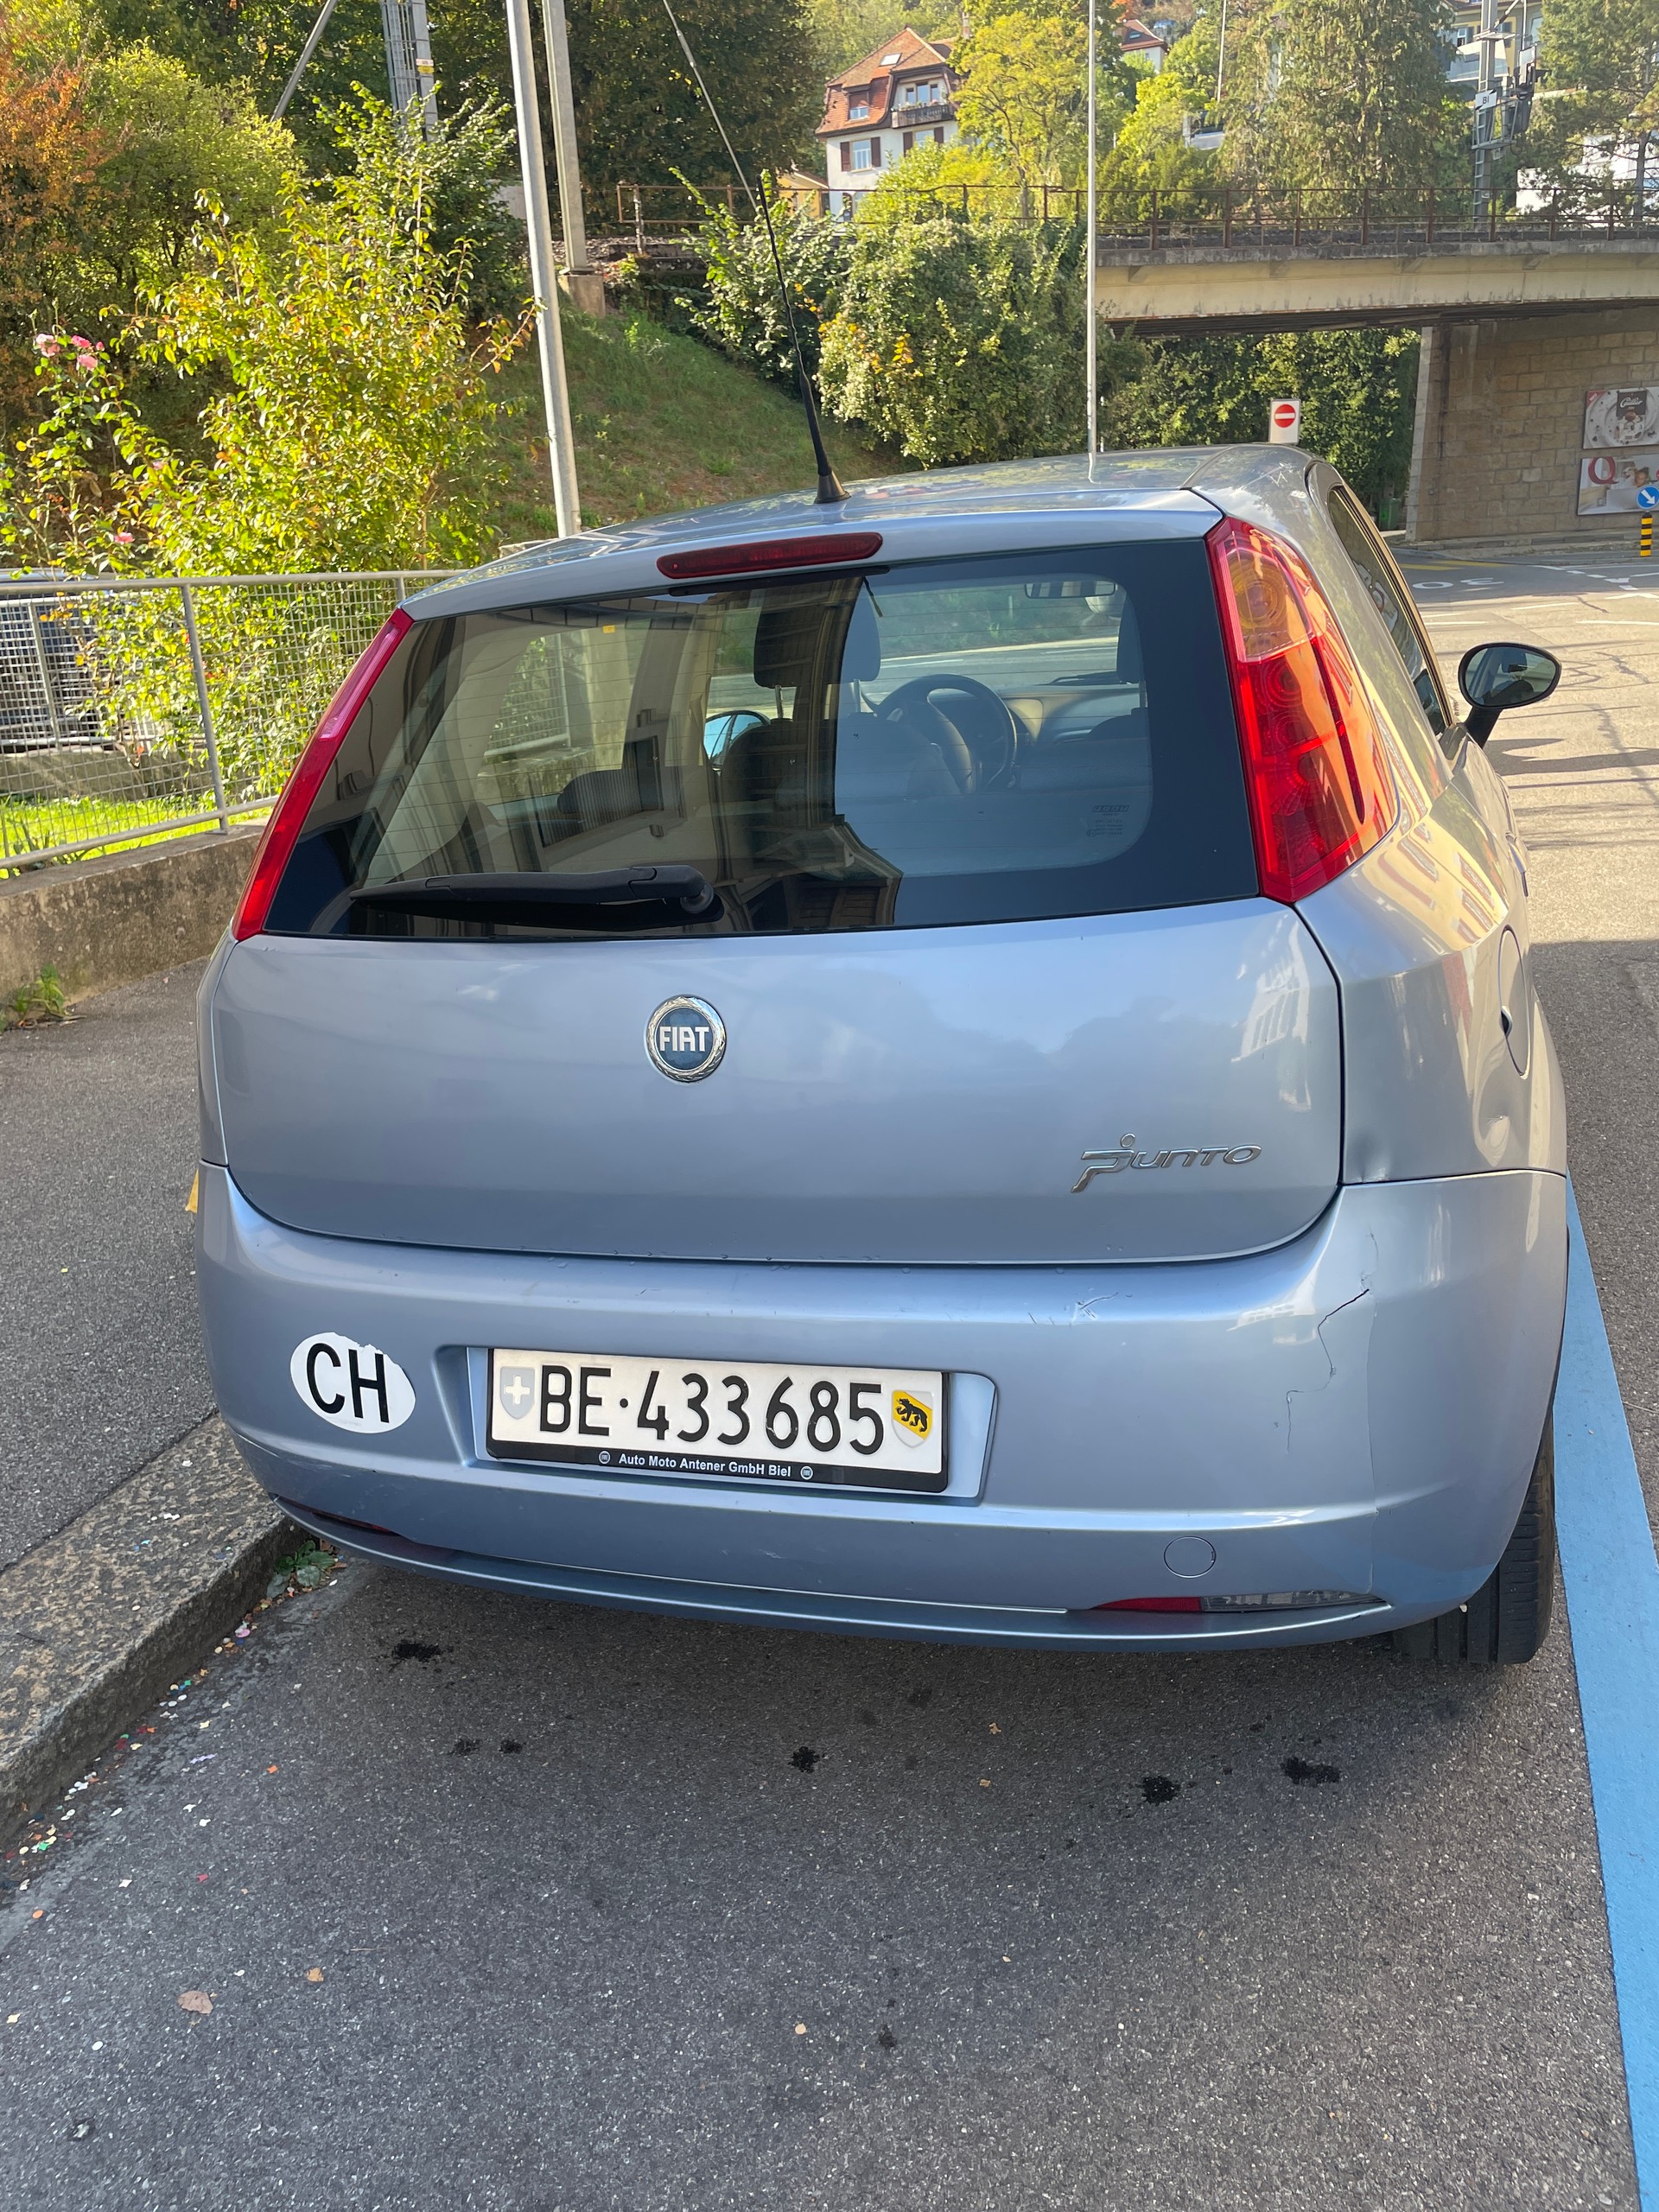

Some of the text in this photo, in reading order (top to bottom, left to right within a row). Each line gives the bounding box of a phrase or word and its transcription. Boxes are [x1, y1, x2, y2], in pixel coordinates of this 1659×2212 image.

[659, 1026, 709, 1052] FIAT
[306, 1342, 390, 1423] CH
[618, 1453, 645, 1466] Auto
[649, 1455, 677, 1468] Moto
[679, 1458, 726, 1471] Antener
[728, 1462, 766, 1475] GmbH
[768, 1465, 791, 1477] Biel
